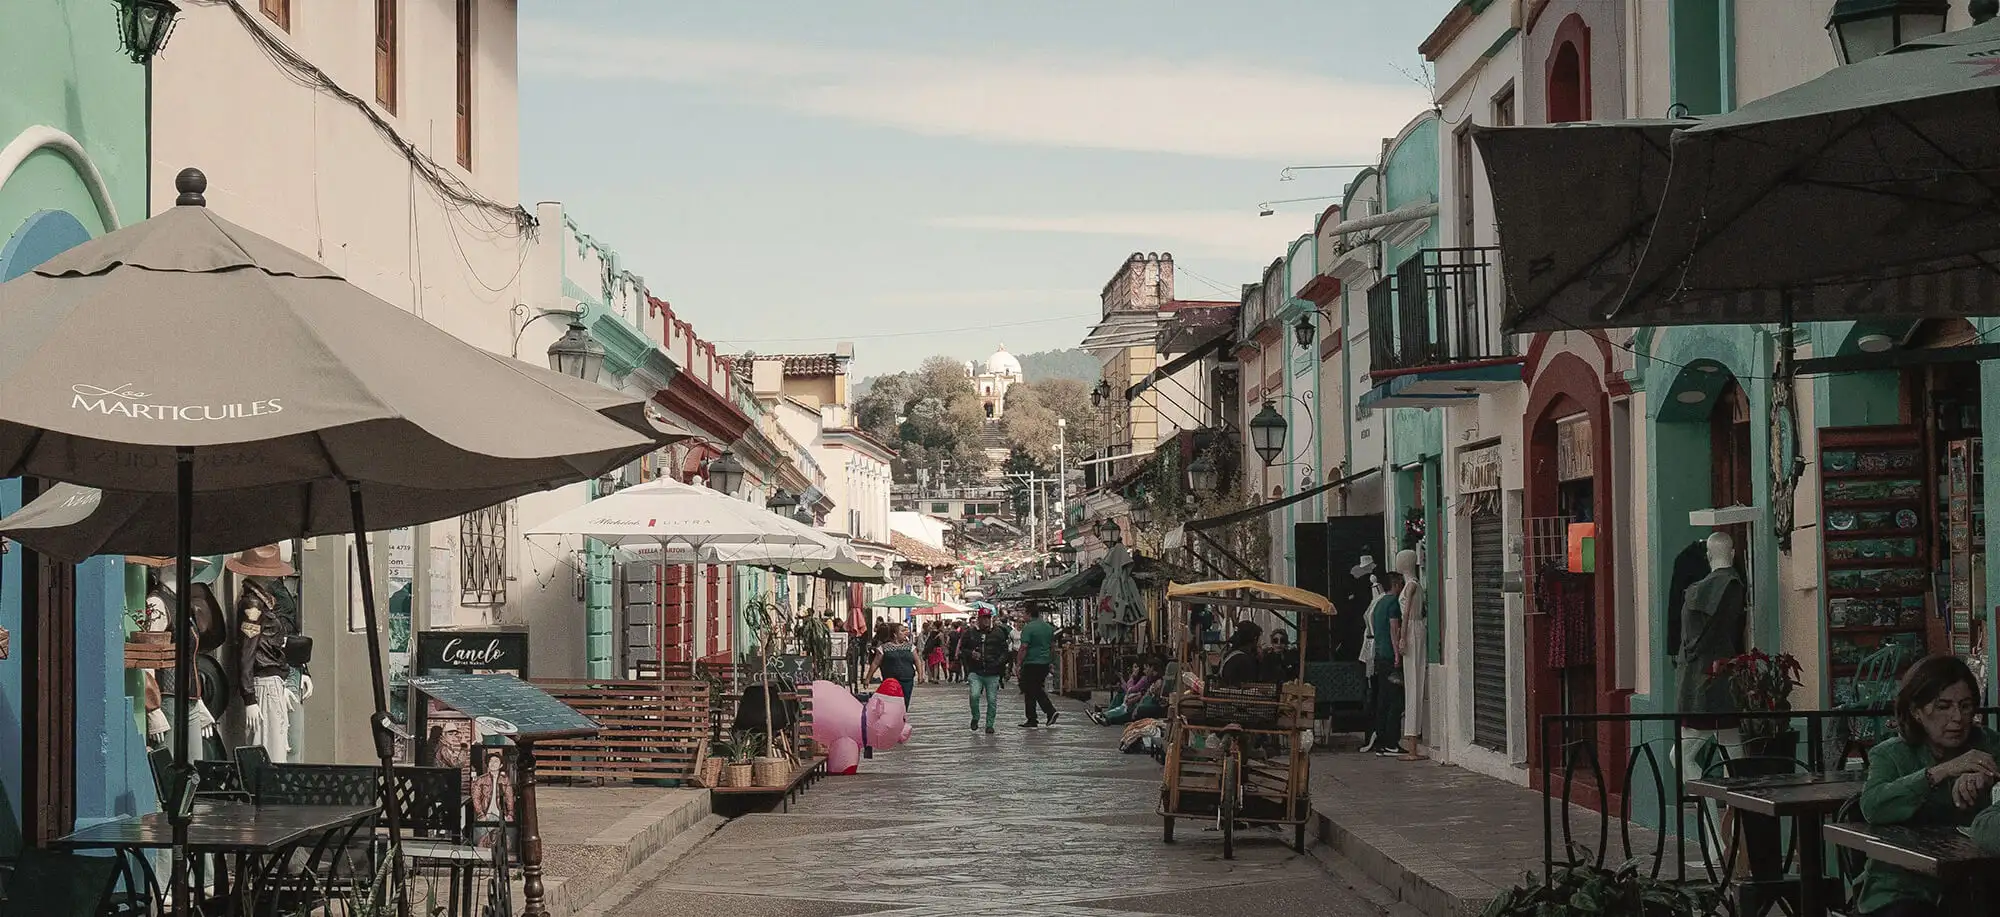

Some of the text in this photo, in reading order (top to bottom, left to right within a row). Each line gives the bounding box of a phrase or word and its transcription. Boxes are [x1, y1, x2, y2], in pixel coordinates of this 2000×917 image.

[72, 382, 153, 399] Los
[71, 394, 284, 421] MARTICUILES
[638, 546, 687, 556] STELLA ARTOIS
[442, 638, 505, 663] Canelo
